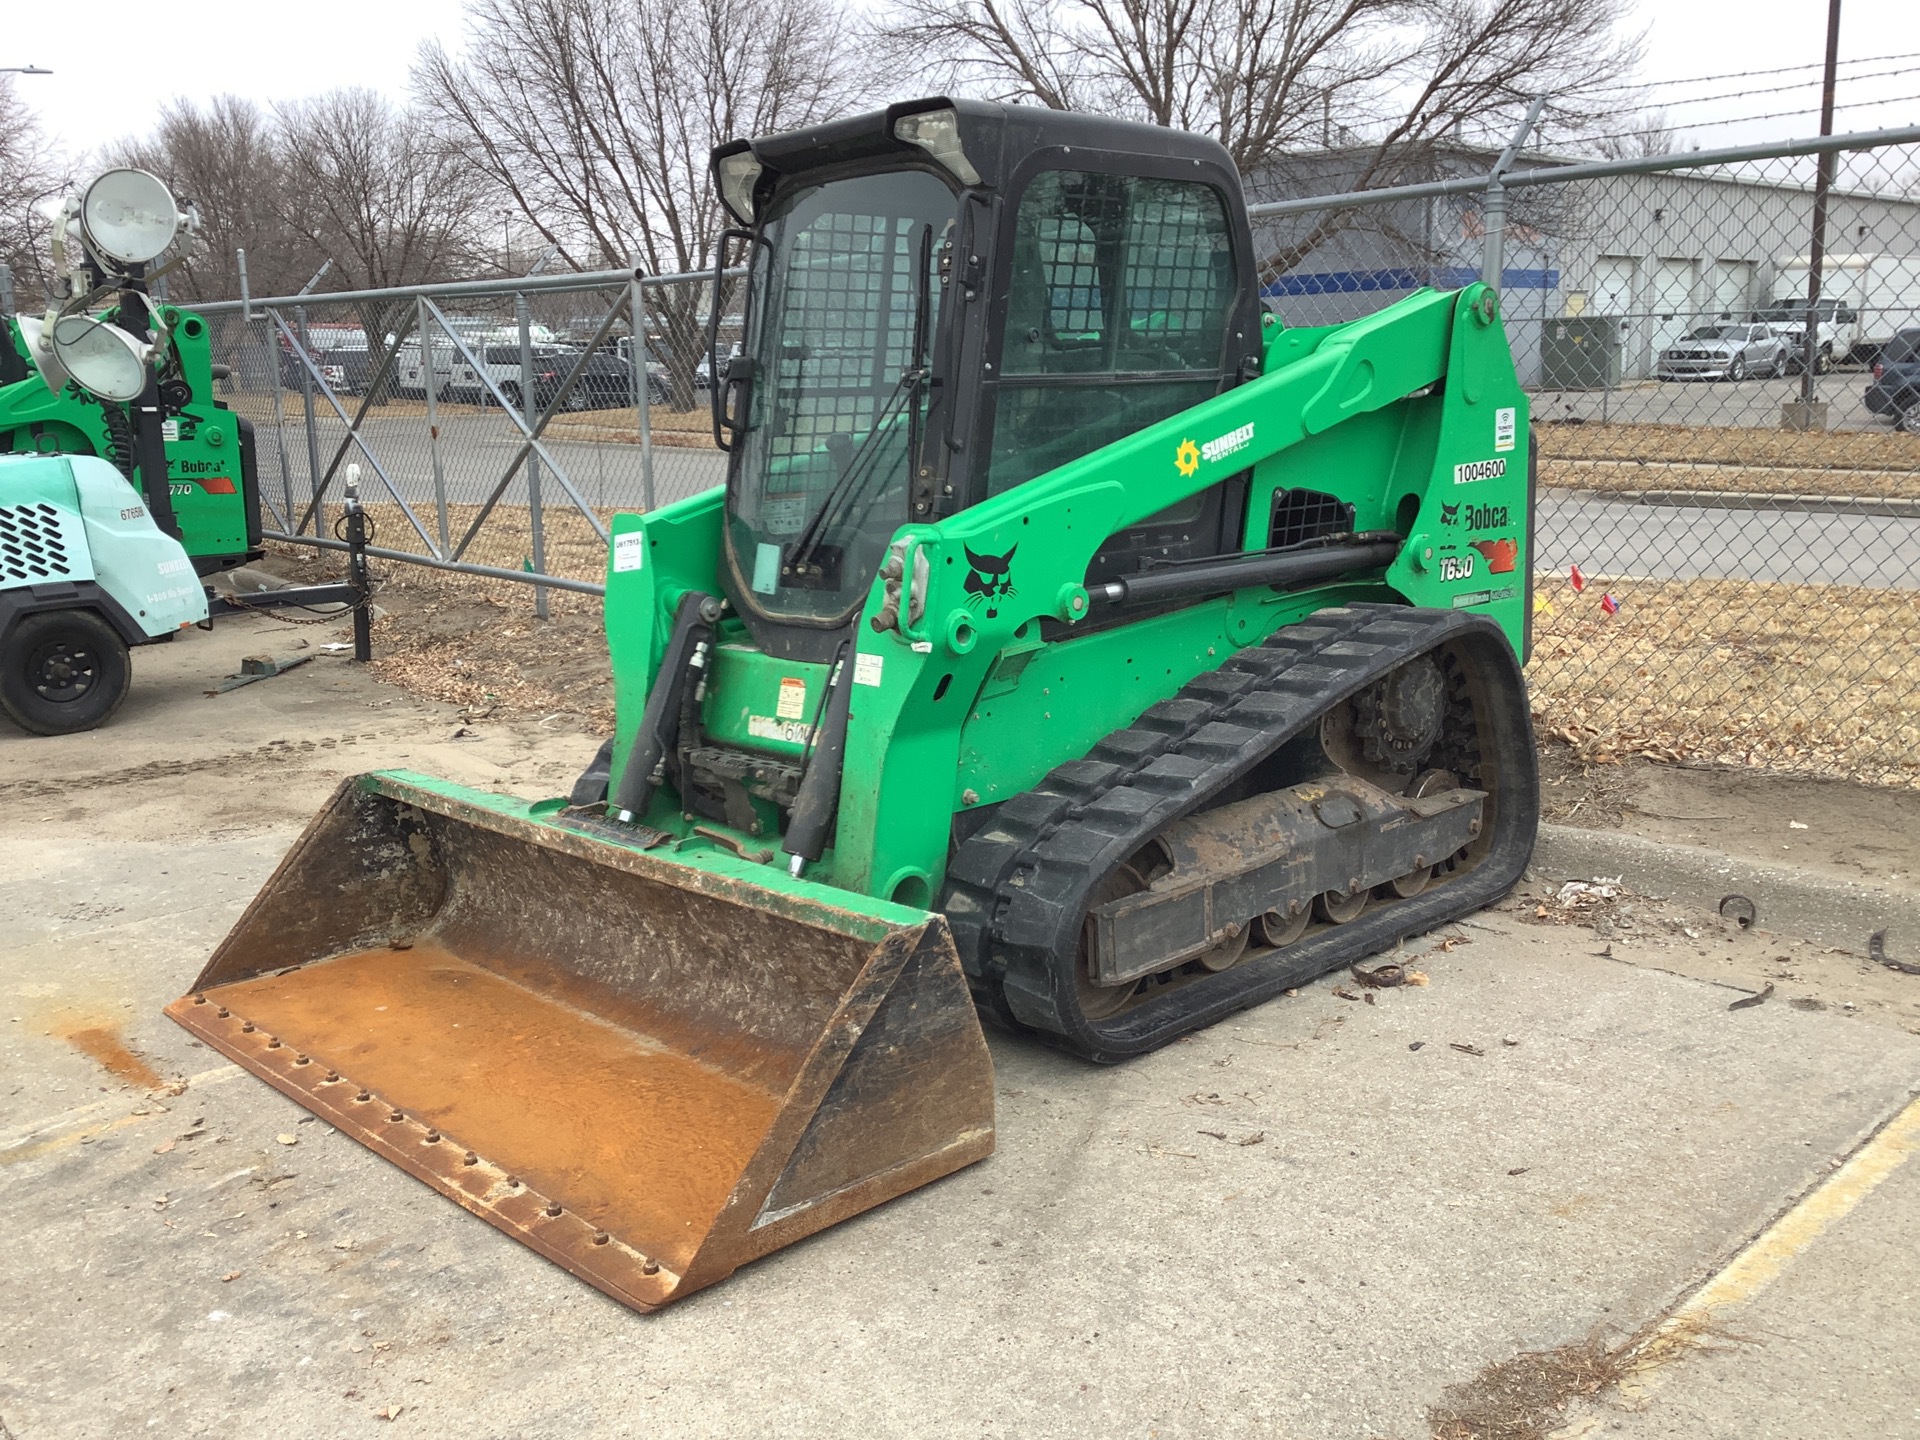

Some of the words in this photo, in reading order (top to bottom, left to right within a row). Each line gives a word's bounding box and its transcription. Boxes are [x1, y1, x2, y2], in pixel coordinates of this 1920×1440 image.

[1202, 422, 1255, 460] SUNBELT
[181, 459, 225, 473] Bobca
[1458, 459, 1505, 483] 1004600
[1465, 502, 1510, 532] Bobca
